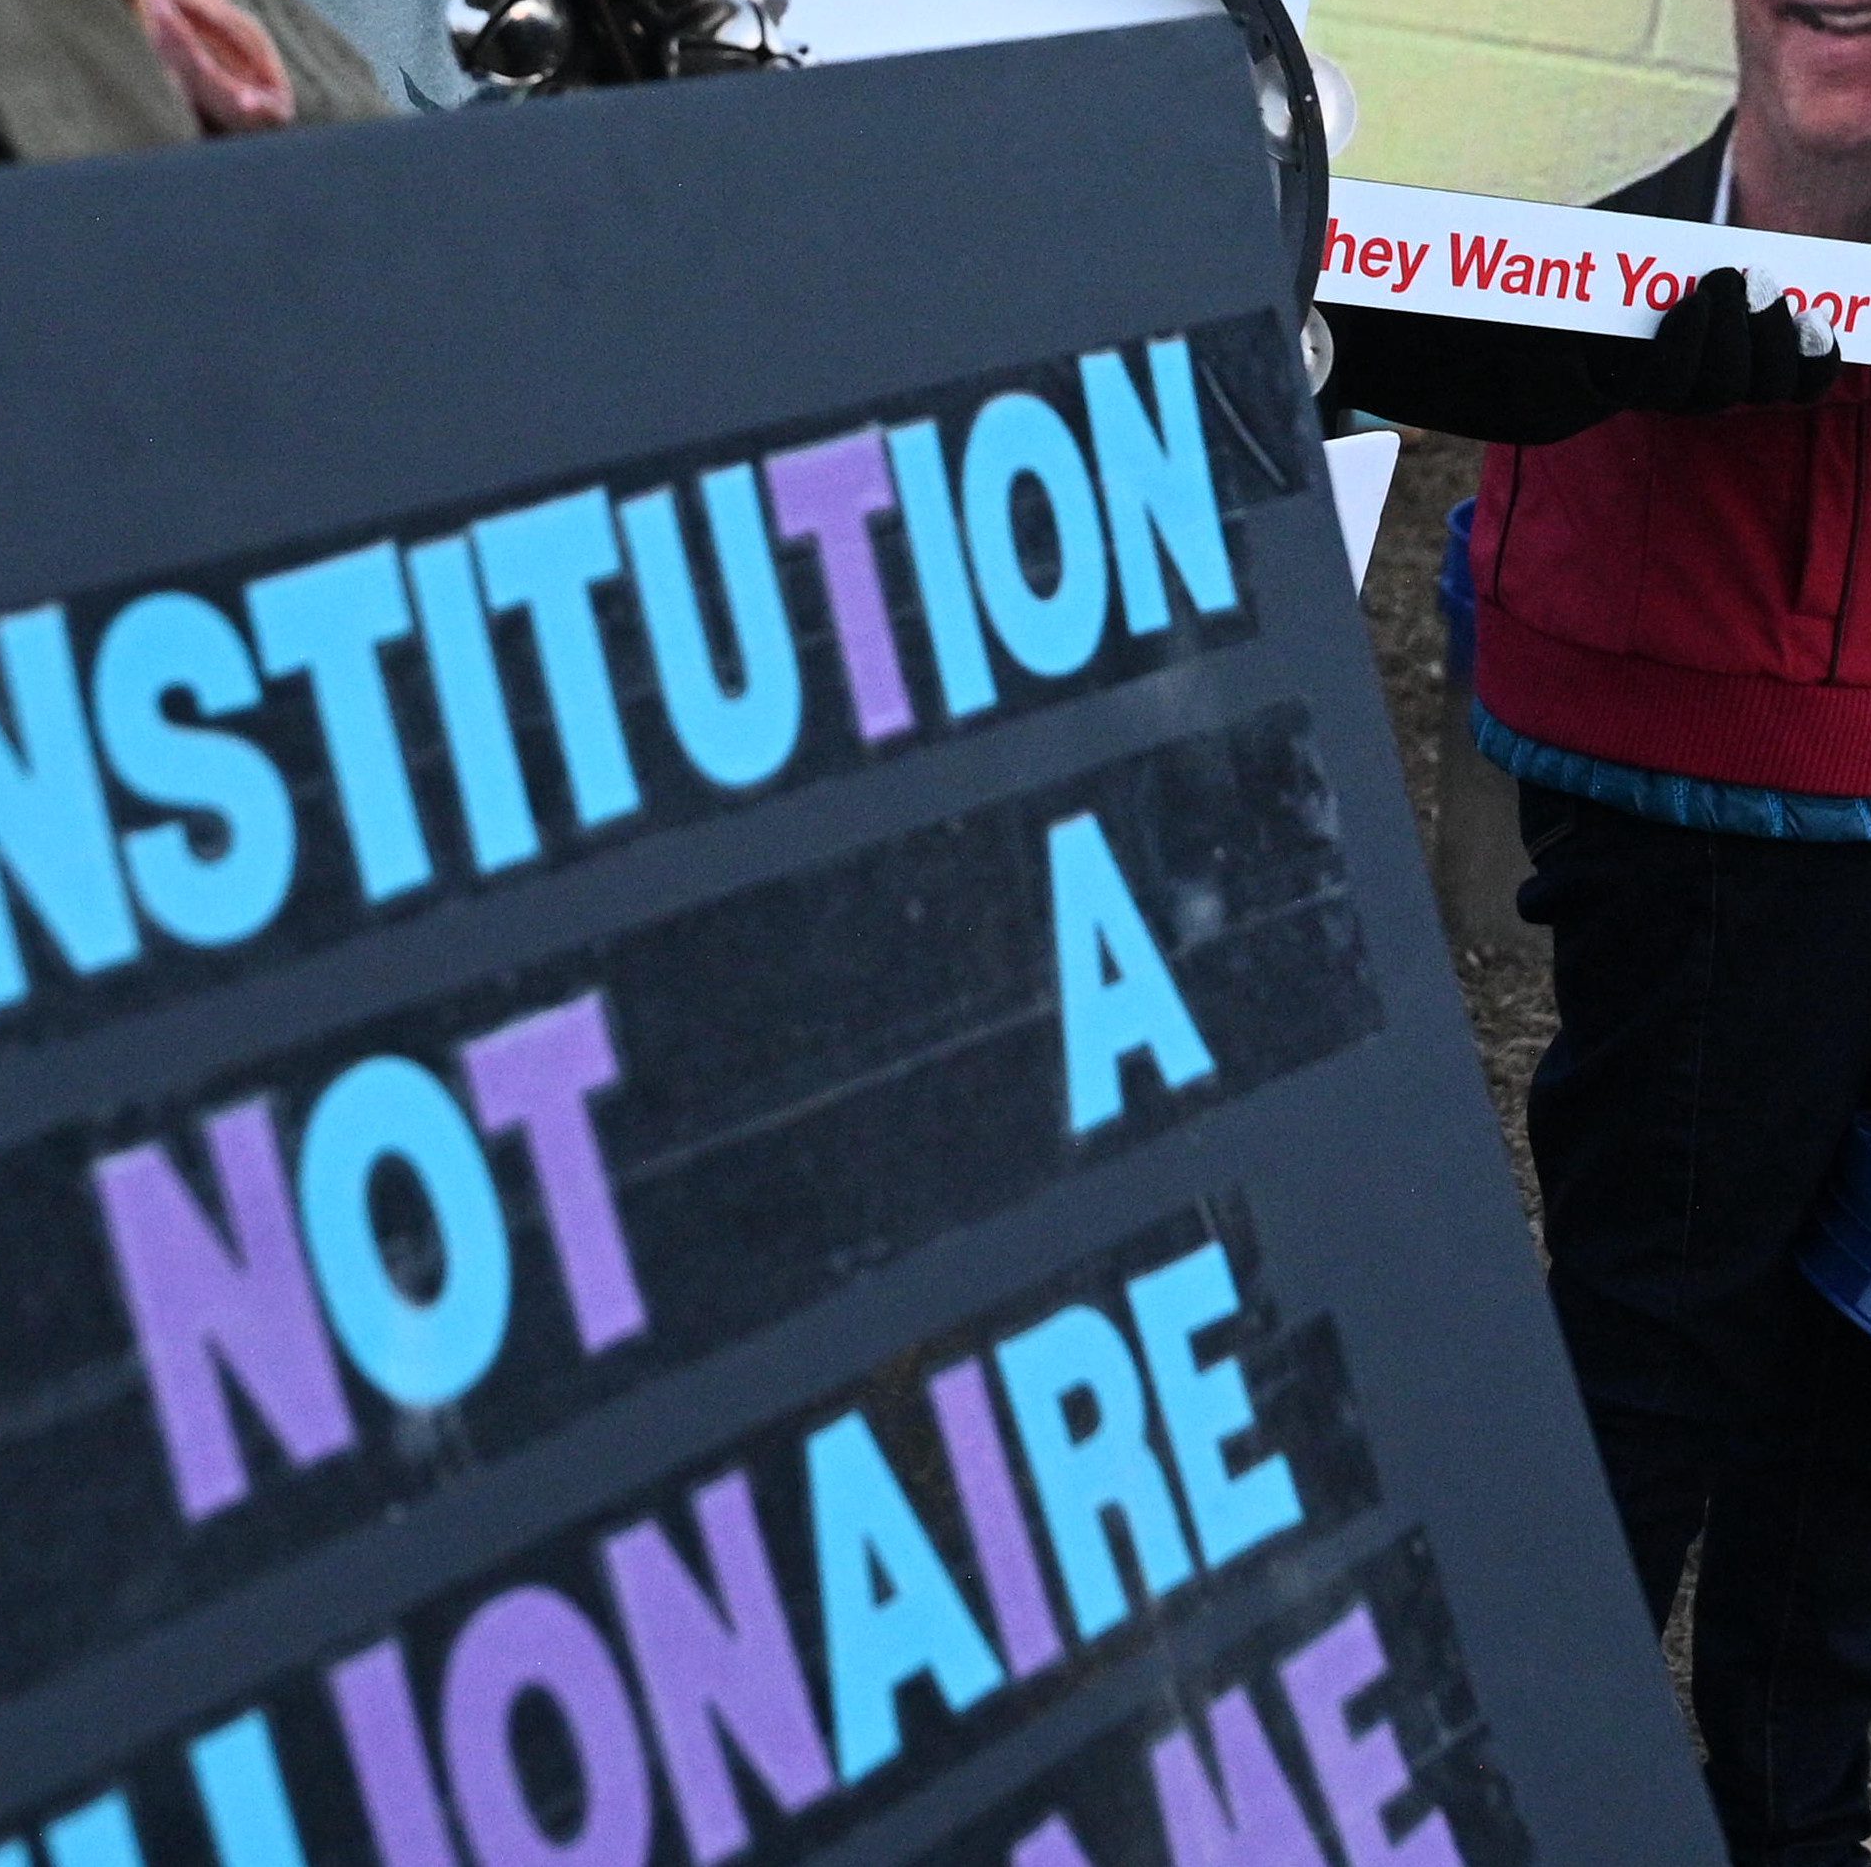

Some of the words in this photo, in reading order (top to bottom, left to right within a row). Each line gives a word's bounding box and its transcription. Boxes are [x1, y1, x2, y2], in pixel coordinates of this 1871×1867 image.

[1320, 217, 1430, 294] hey
[1449, 231, 1598, 303] Want
[92, 990, 648, 1521] NOT
[1044, 810, 1219, 1137] A
[1010, 1601, 1467, 1867] ME
